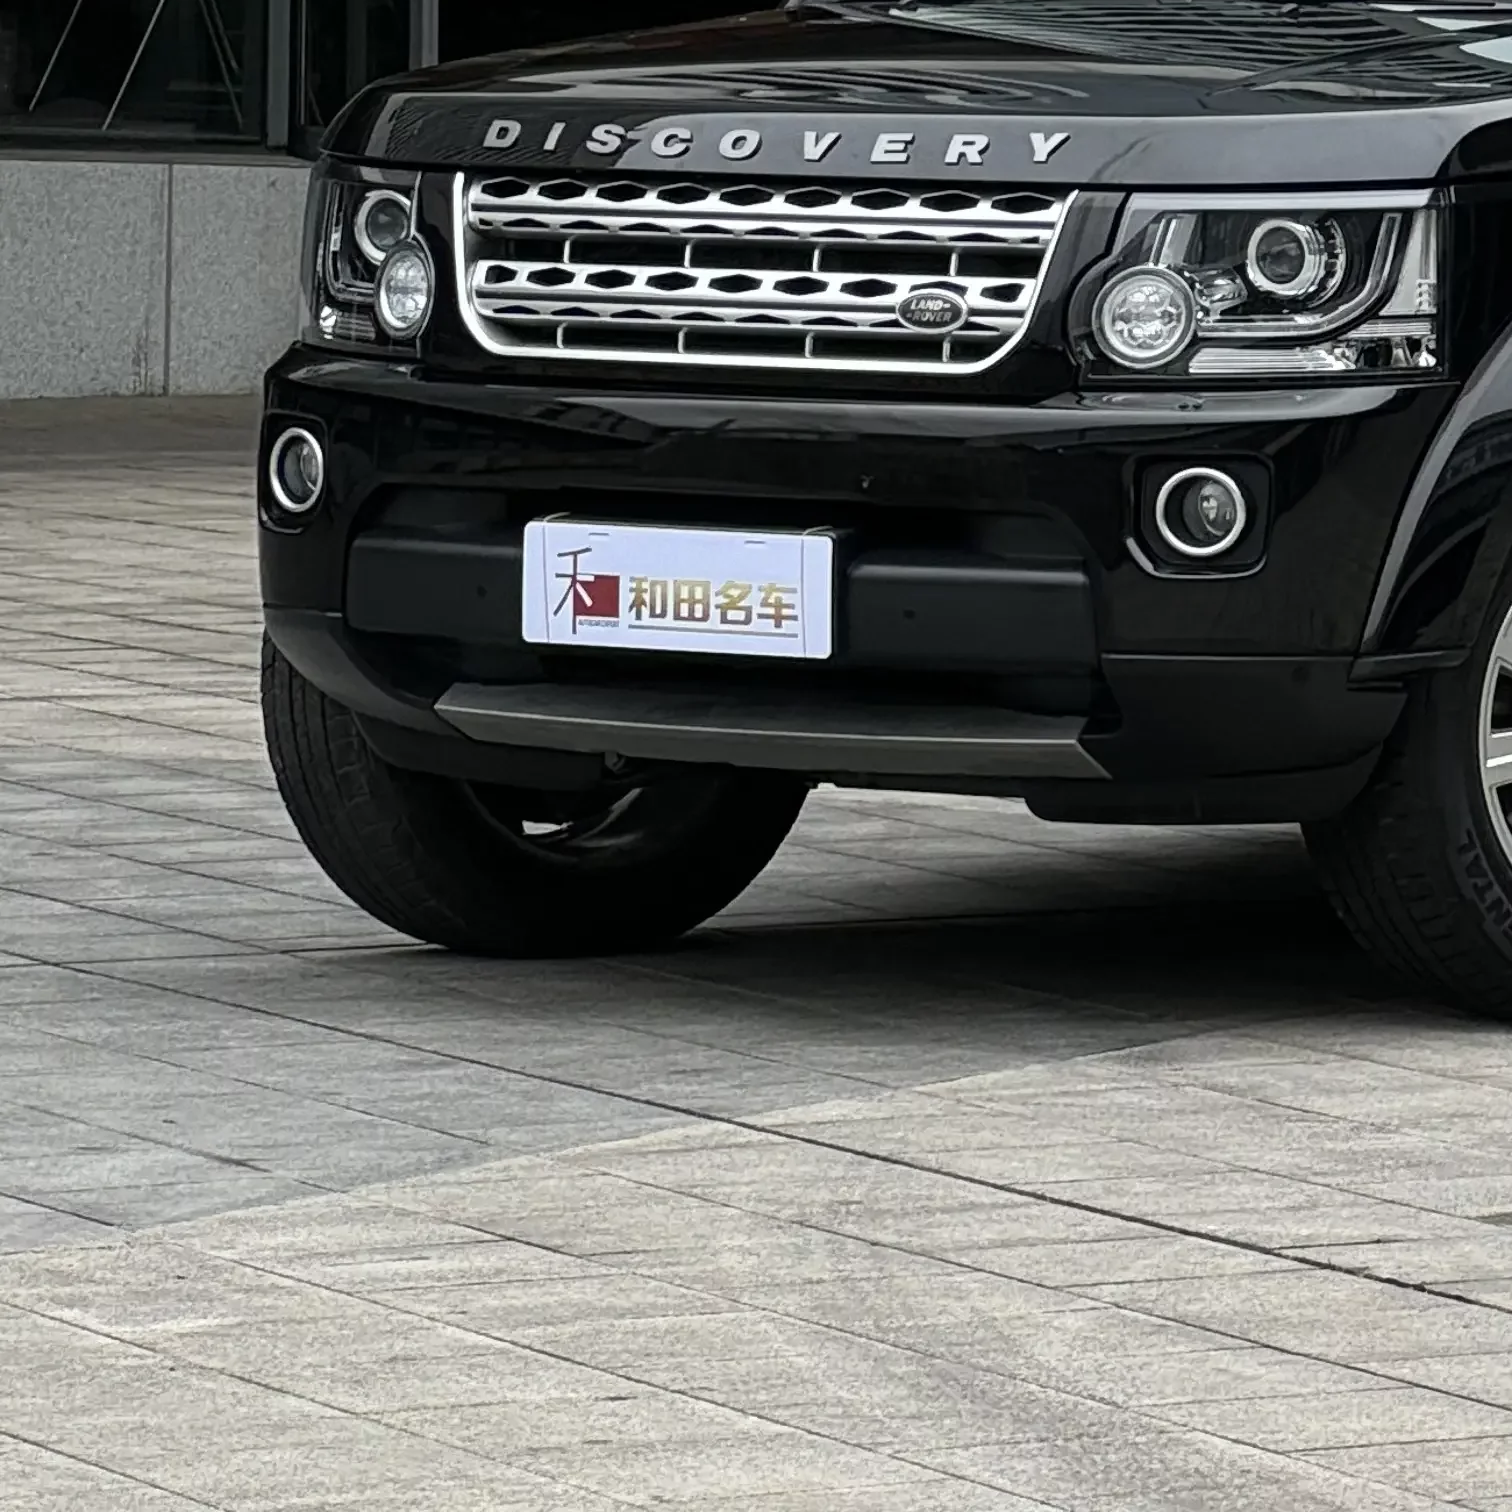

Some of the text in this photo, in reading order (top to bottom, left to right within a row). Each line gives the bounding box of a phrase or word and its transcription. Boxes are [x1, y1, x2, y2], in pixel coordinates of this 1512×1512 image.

[482, 119, 1071, 165] DISCOVERY
[627, 575, 799, 629] 和田名车
